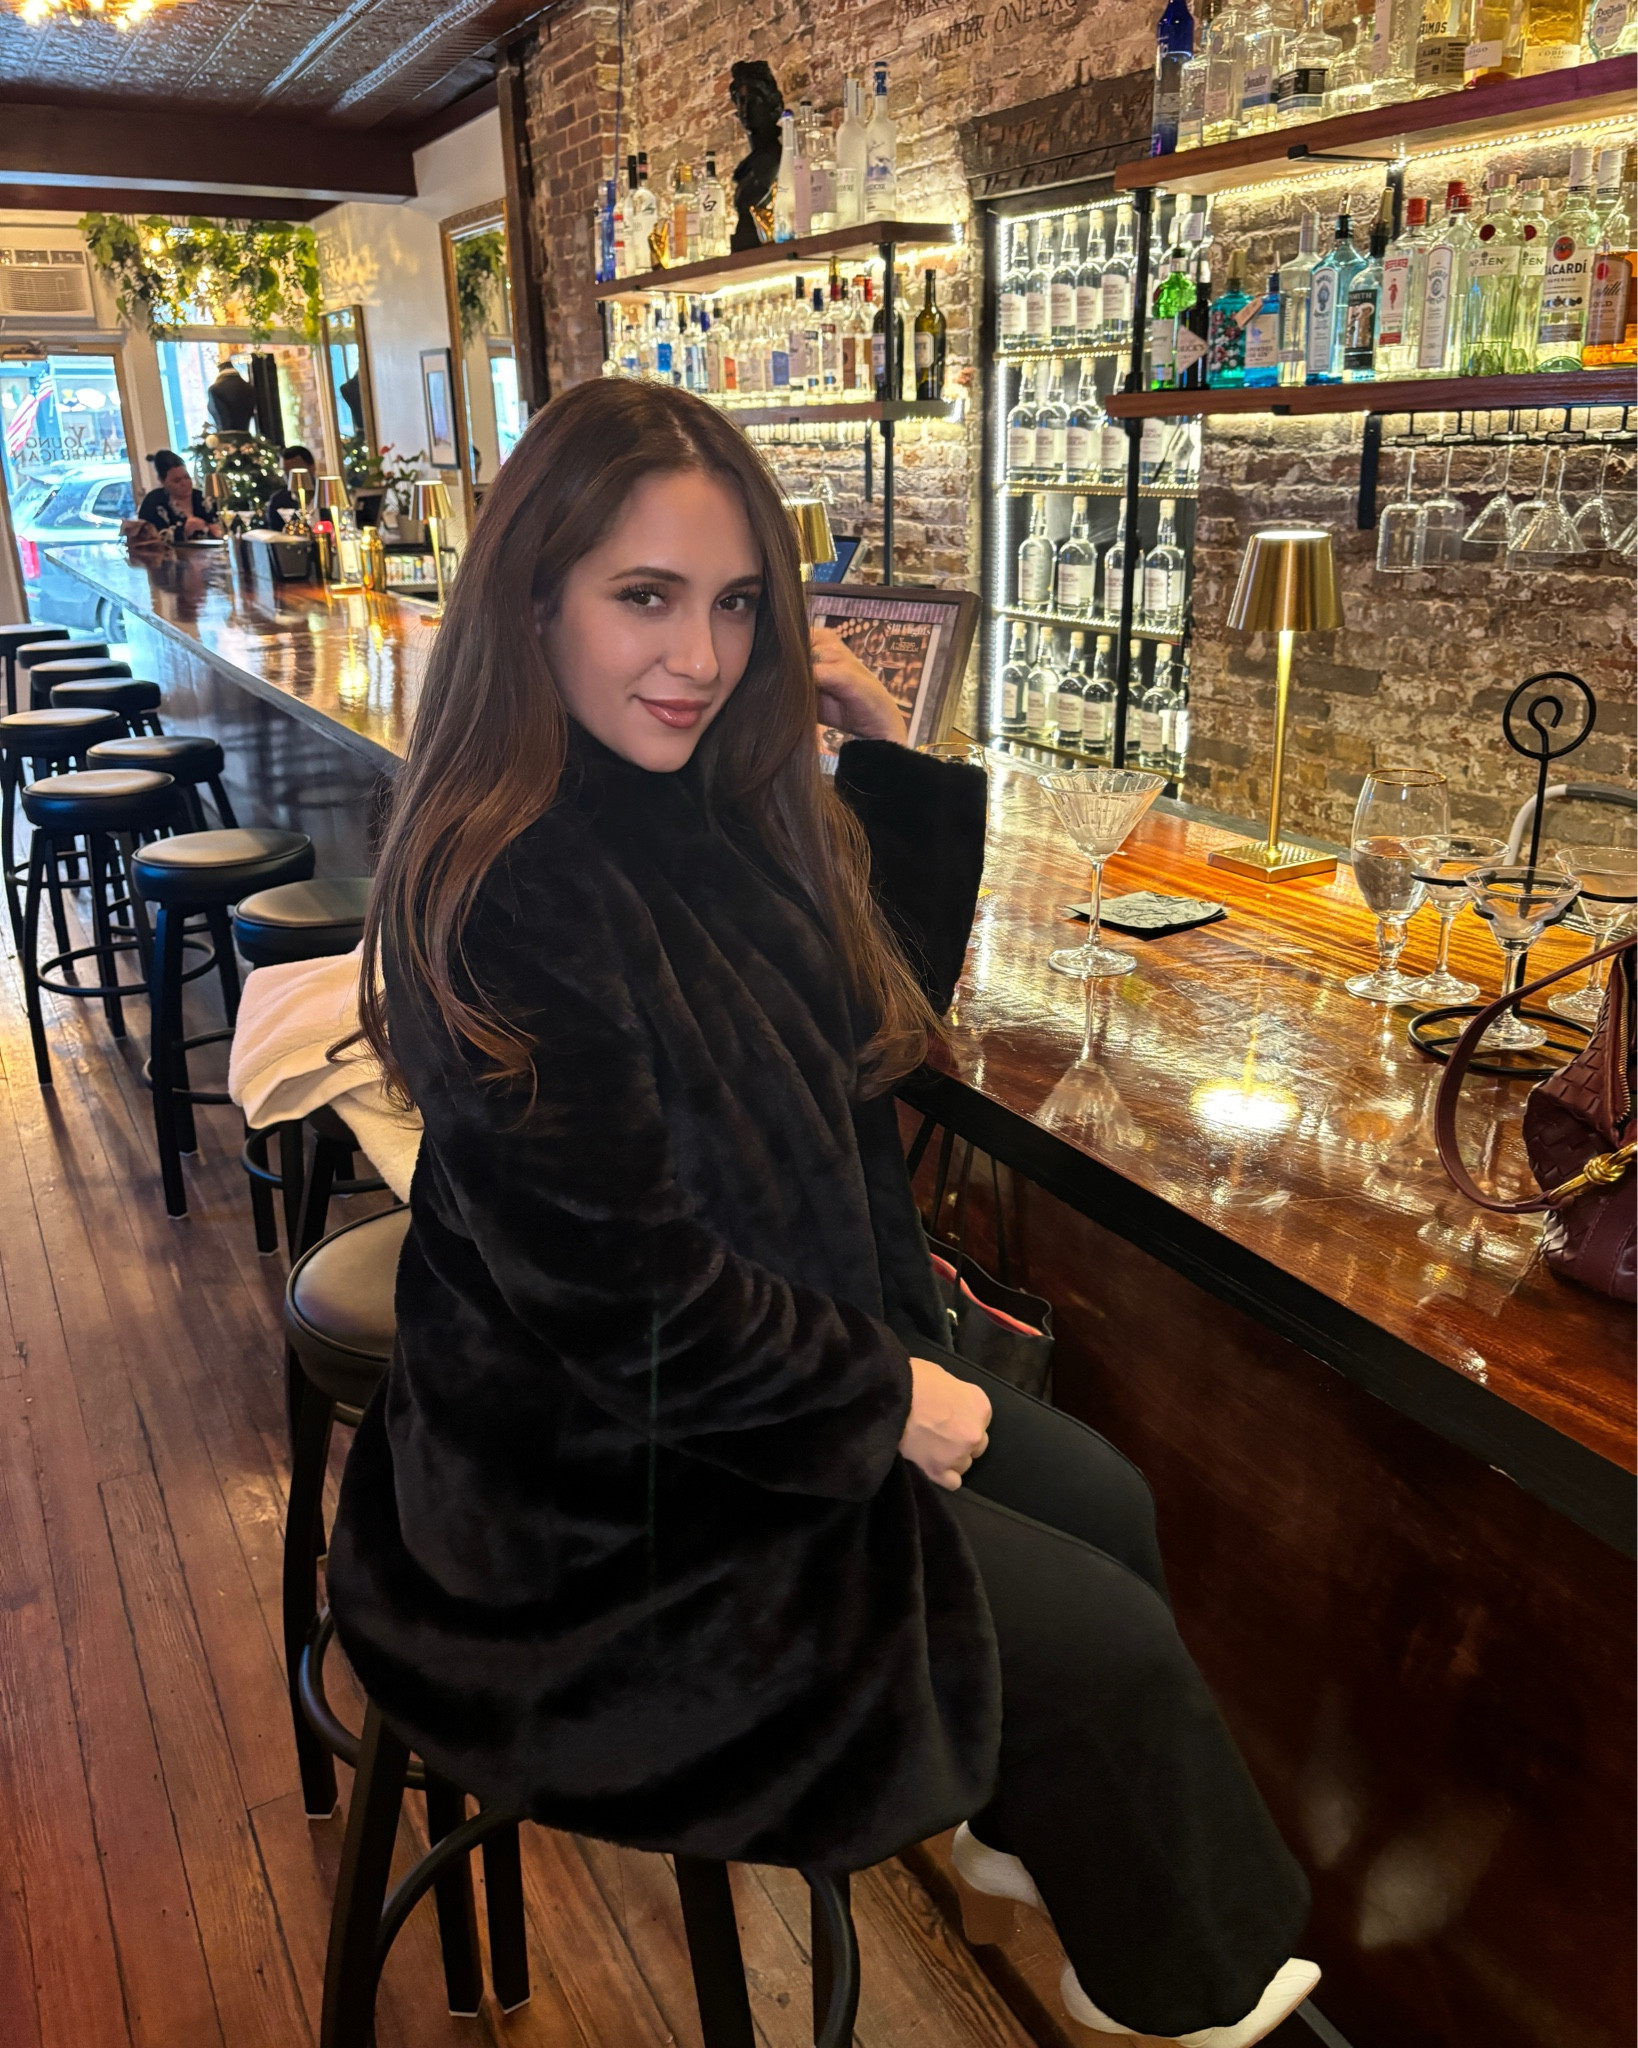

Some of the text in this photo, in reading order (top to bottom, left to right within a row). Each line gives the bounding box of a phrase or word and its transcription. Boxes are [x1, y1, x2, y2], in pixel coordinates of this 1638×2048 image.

[994, 0, 1033, 32] ONE
[1480, 257, 1505, 266] TEN
[1522, 257, 1544, 266] TEN
